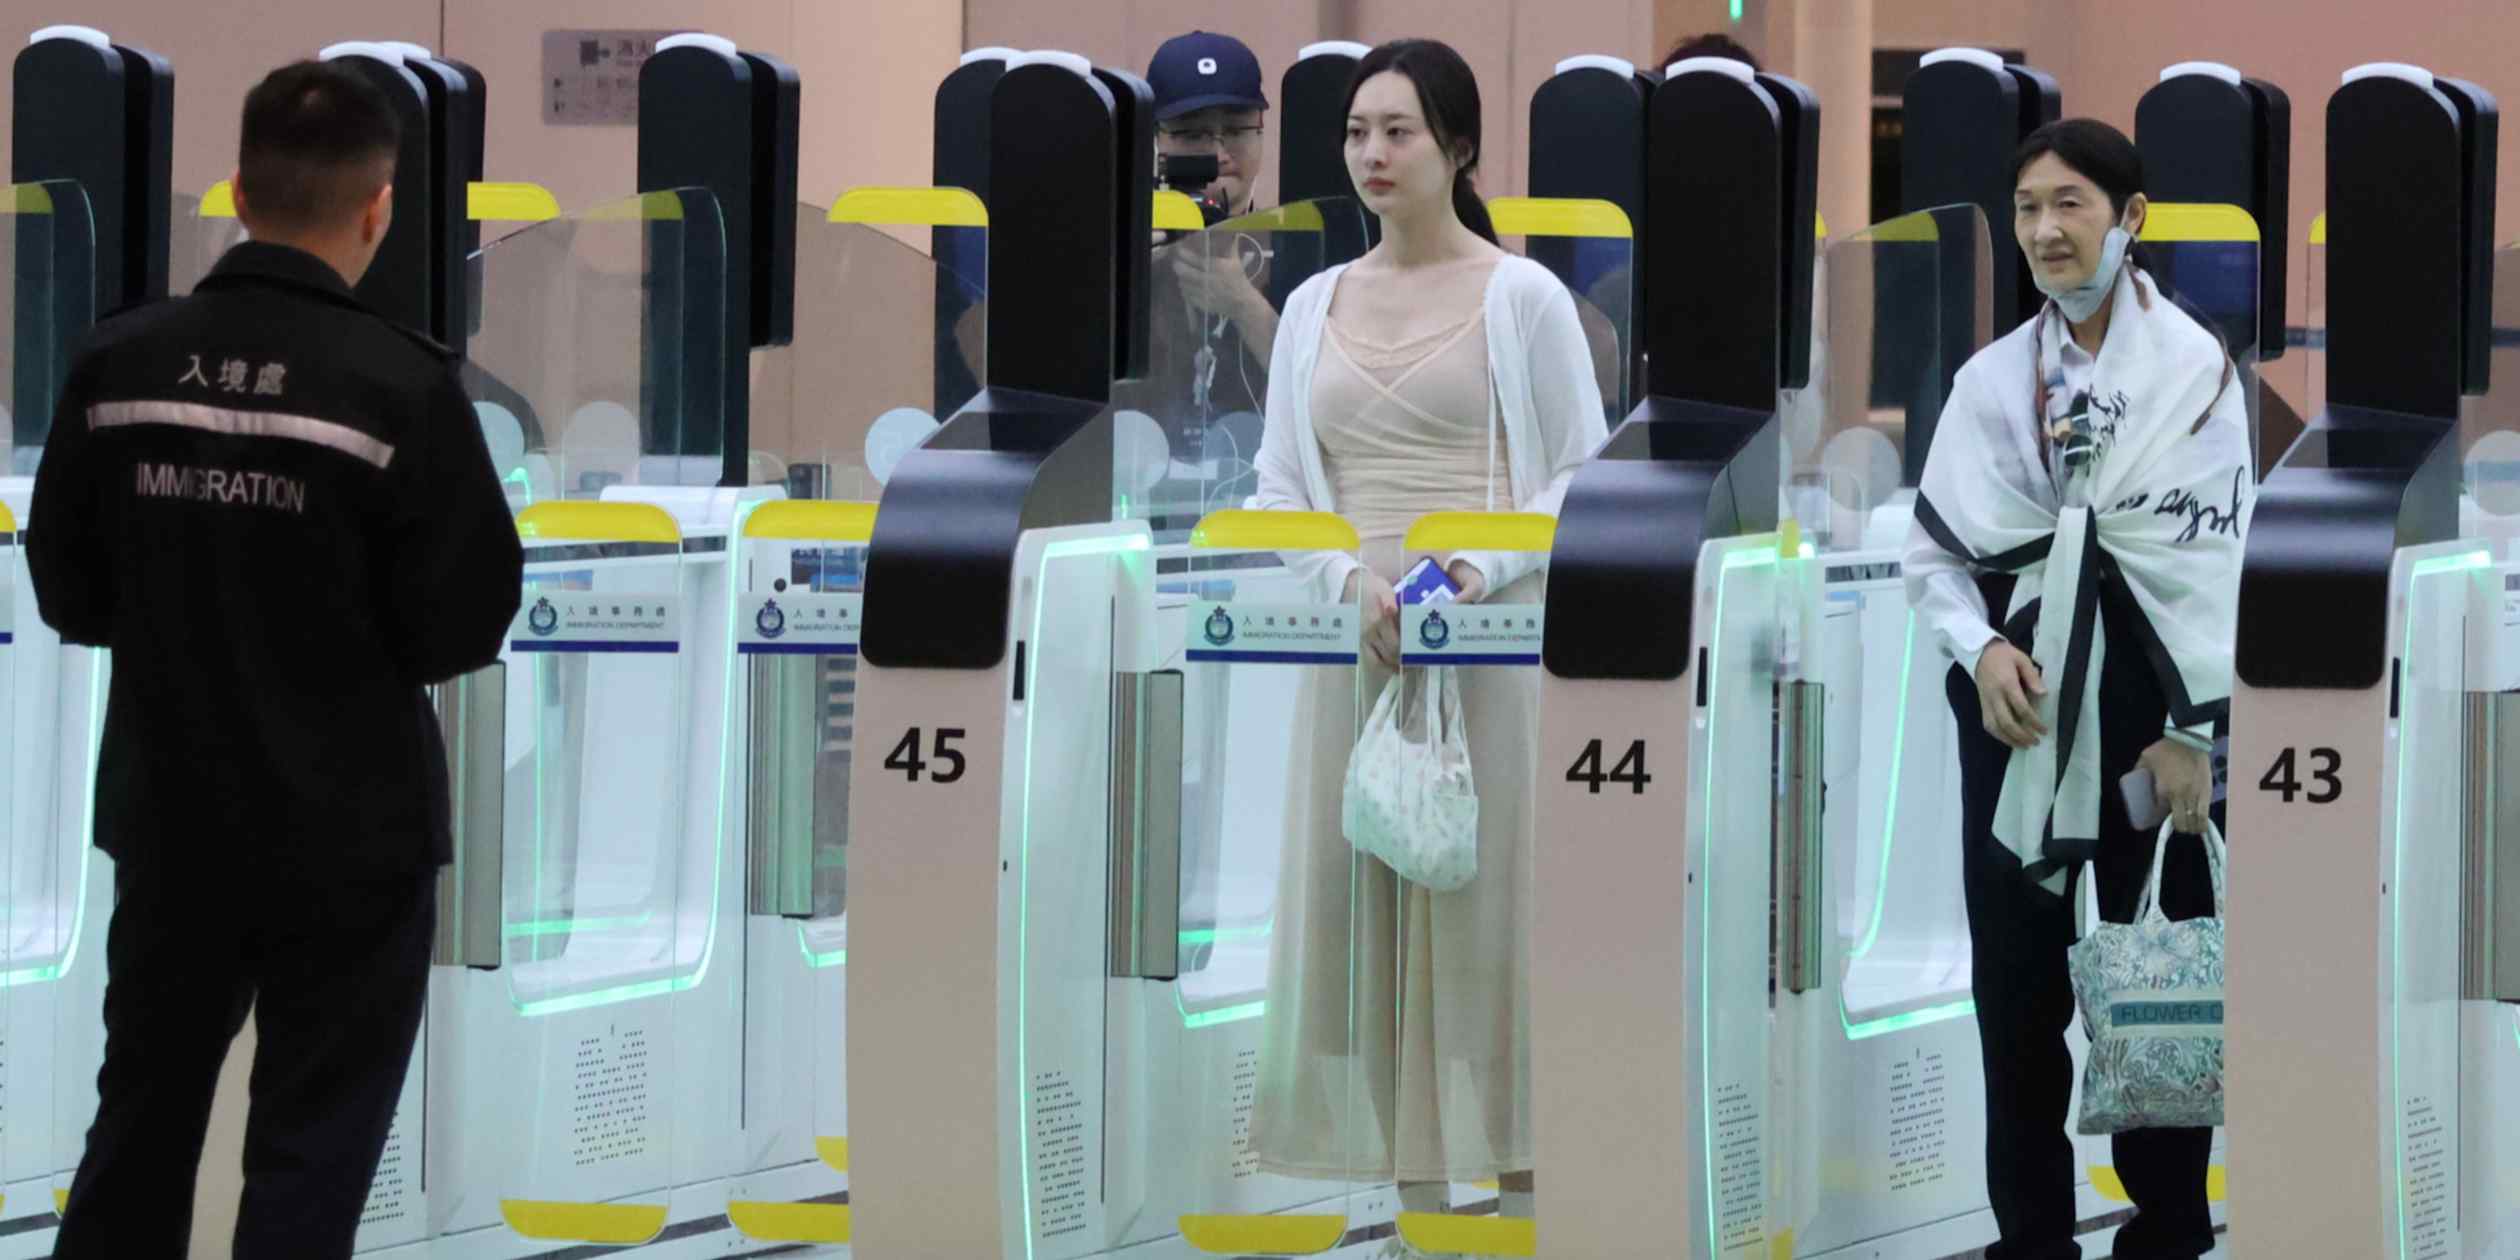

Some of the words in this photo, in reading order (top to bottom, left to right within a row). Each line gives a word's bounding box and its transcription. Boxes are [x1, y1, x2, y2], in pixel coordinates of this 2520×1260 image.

[178, 354, 287, 395] 入境處
[136, 463, 305, 513] IMMIGRATION
[885, 728, 966, 784] 45
[1565, 739, 1652, 795] 44
[2258, 747, 2343, 804] 43
[2121, 1003, 2201, 1022] FLOWER
